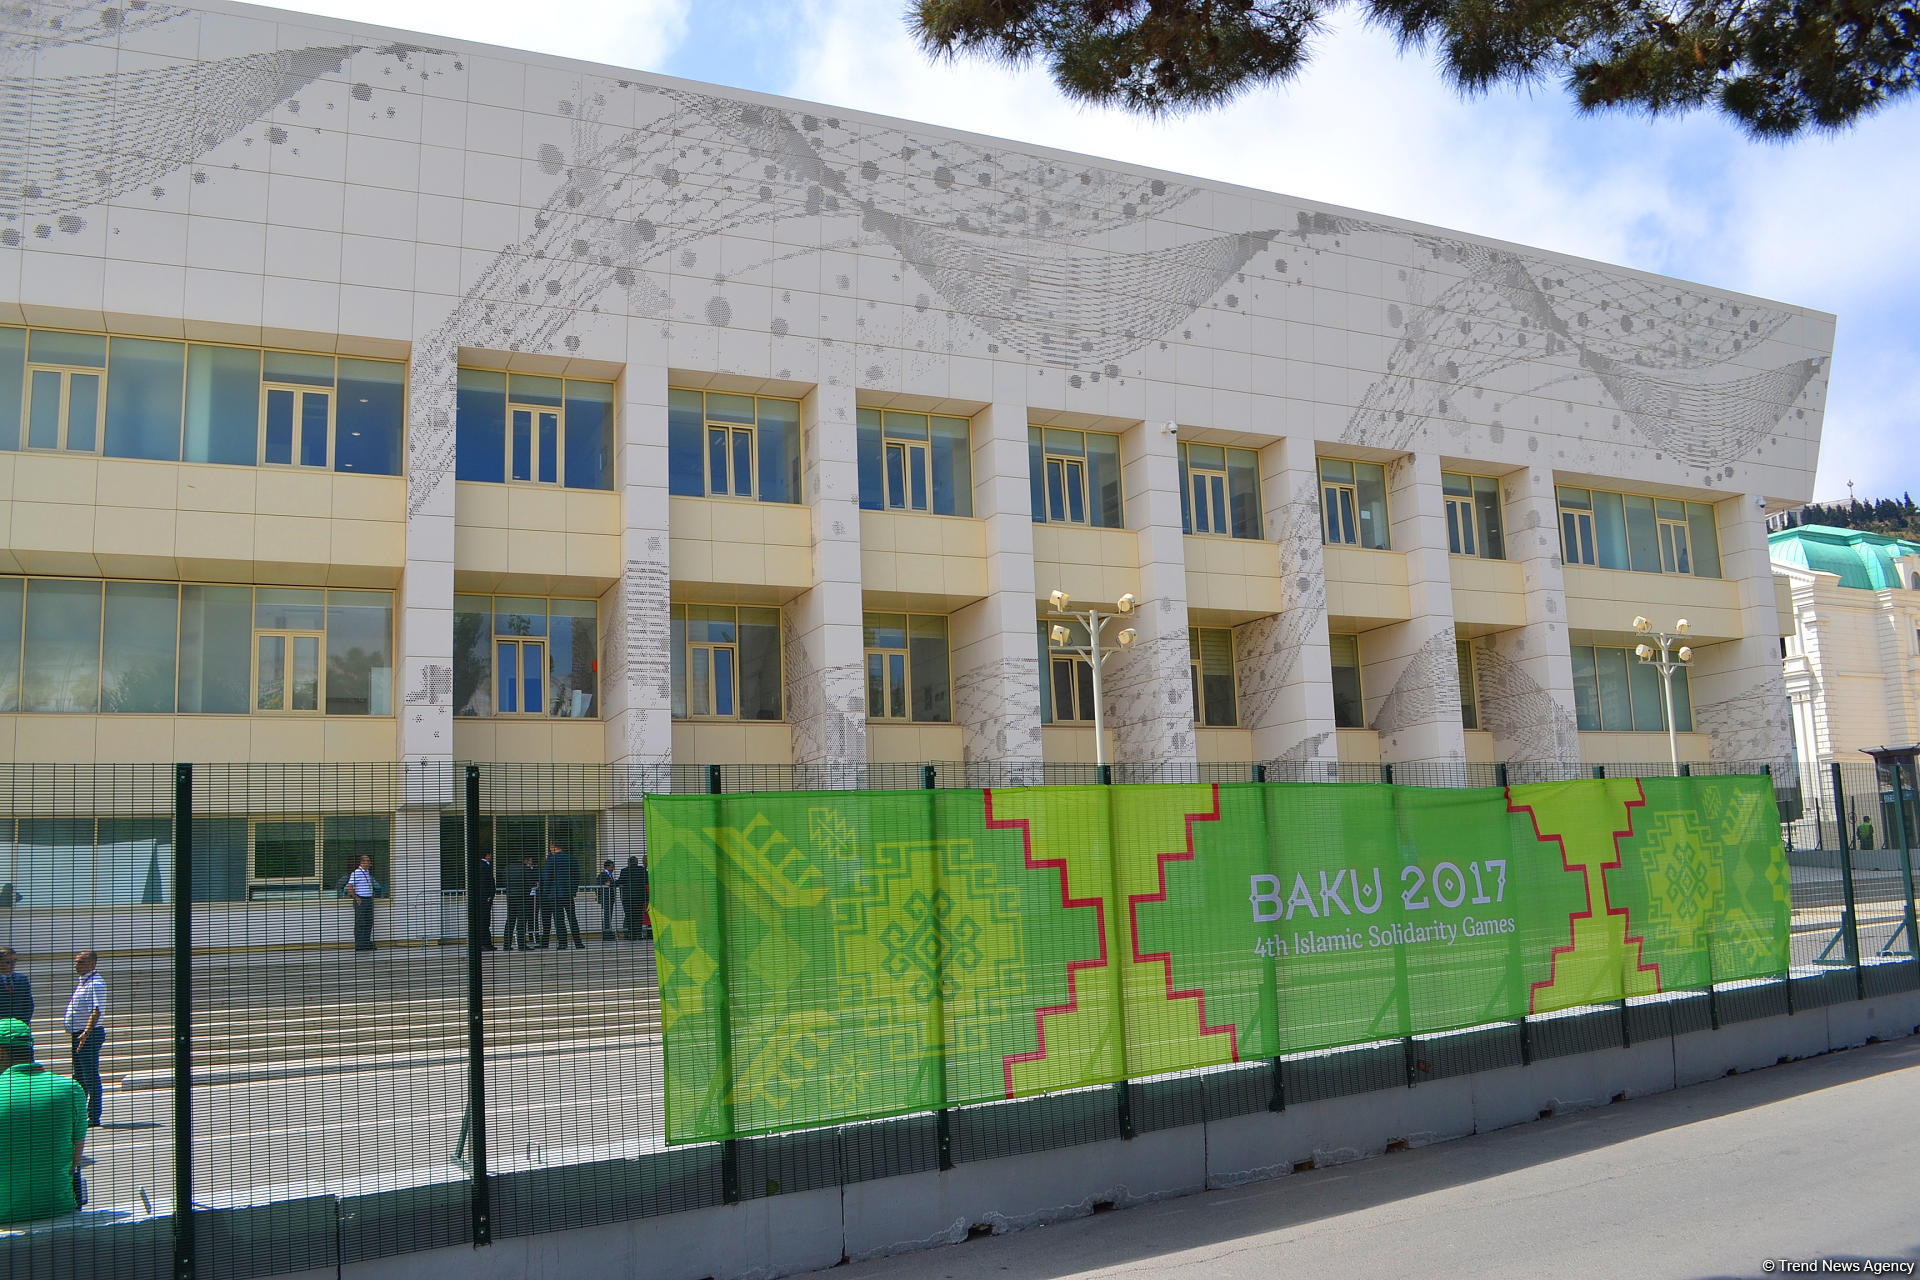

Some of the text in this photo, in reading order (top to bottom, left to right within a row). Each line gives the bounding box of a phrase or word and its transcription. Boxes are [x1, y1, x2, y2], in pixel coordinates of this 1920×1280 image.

[1249, 859, 1507, 923] BAKU 2017
[1254, 915, 1516, 959] 4th Islamic Solidarity Games
